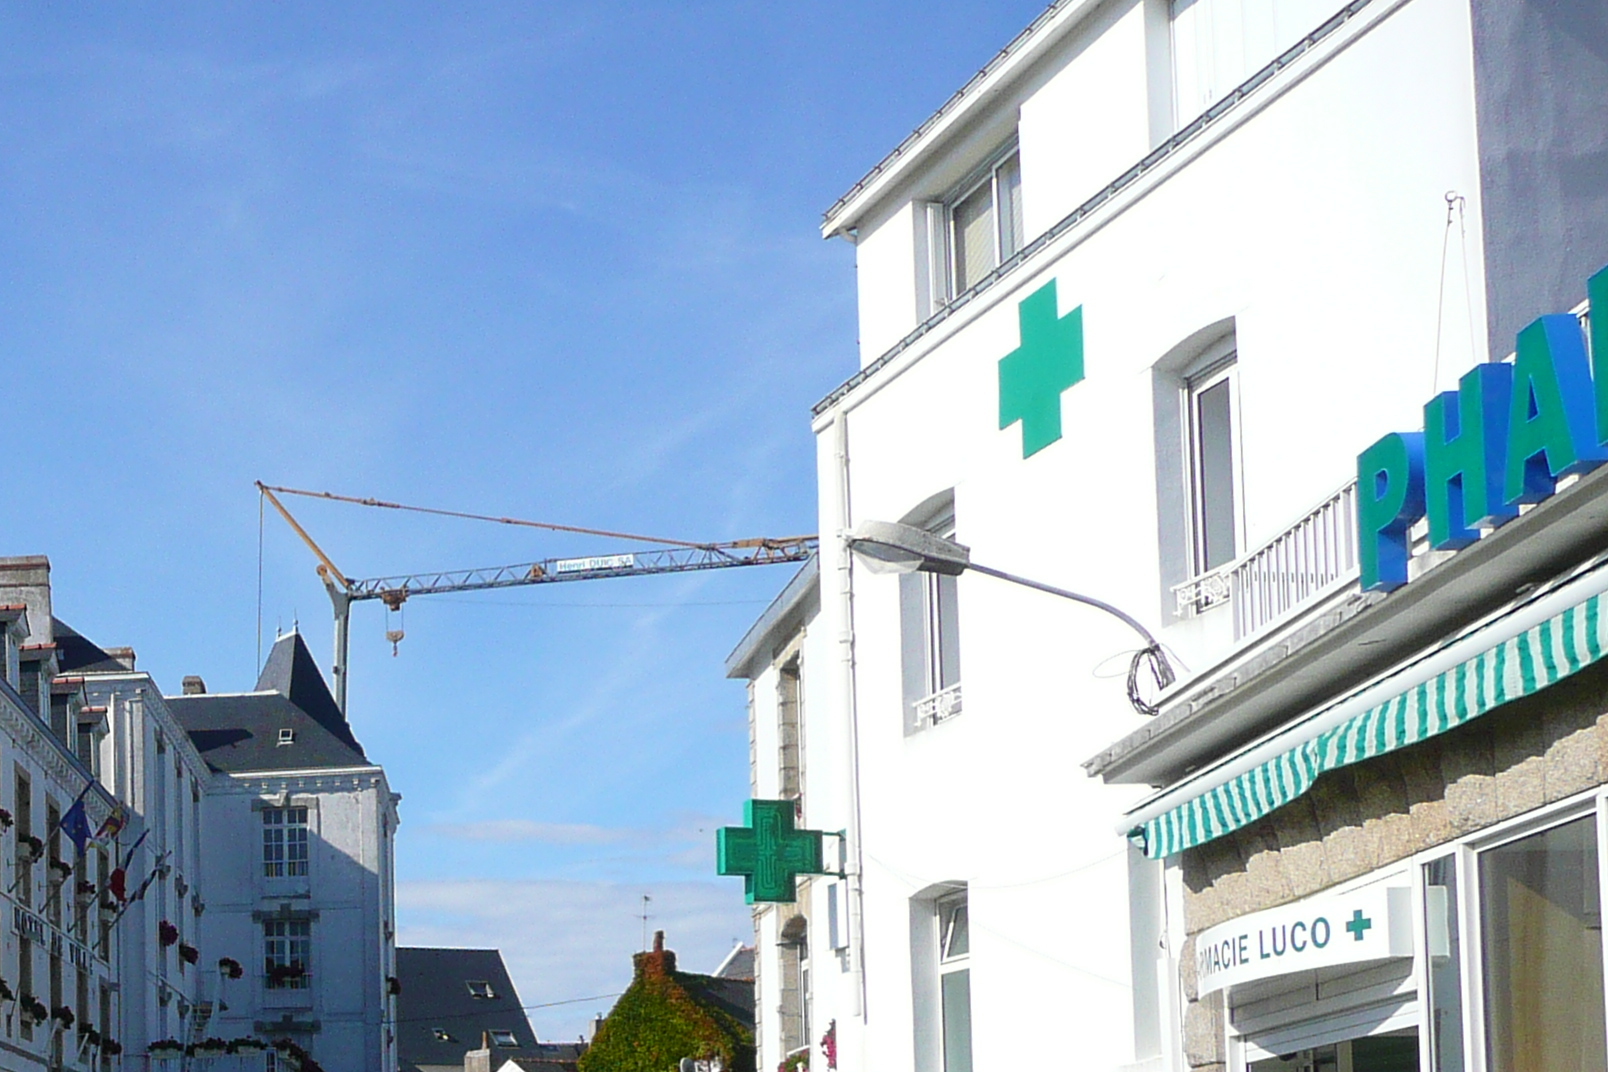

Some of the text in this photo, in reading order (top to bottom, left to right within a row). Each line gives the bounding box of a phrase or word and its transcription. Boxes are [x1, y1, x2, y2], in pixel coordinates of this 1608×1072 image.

[559, 561, 586, 572] Henri
[52, 930, 63, 957] DE
[68, 942, 94, 976] VILLE
[1259, 916, 1331, 960] LUCO
